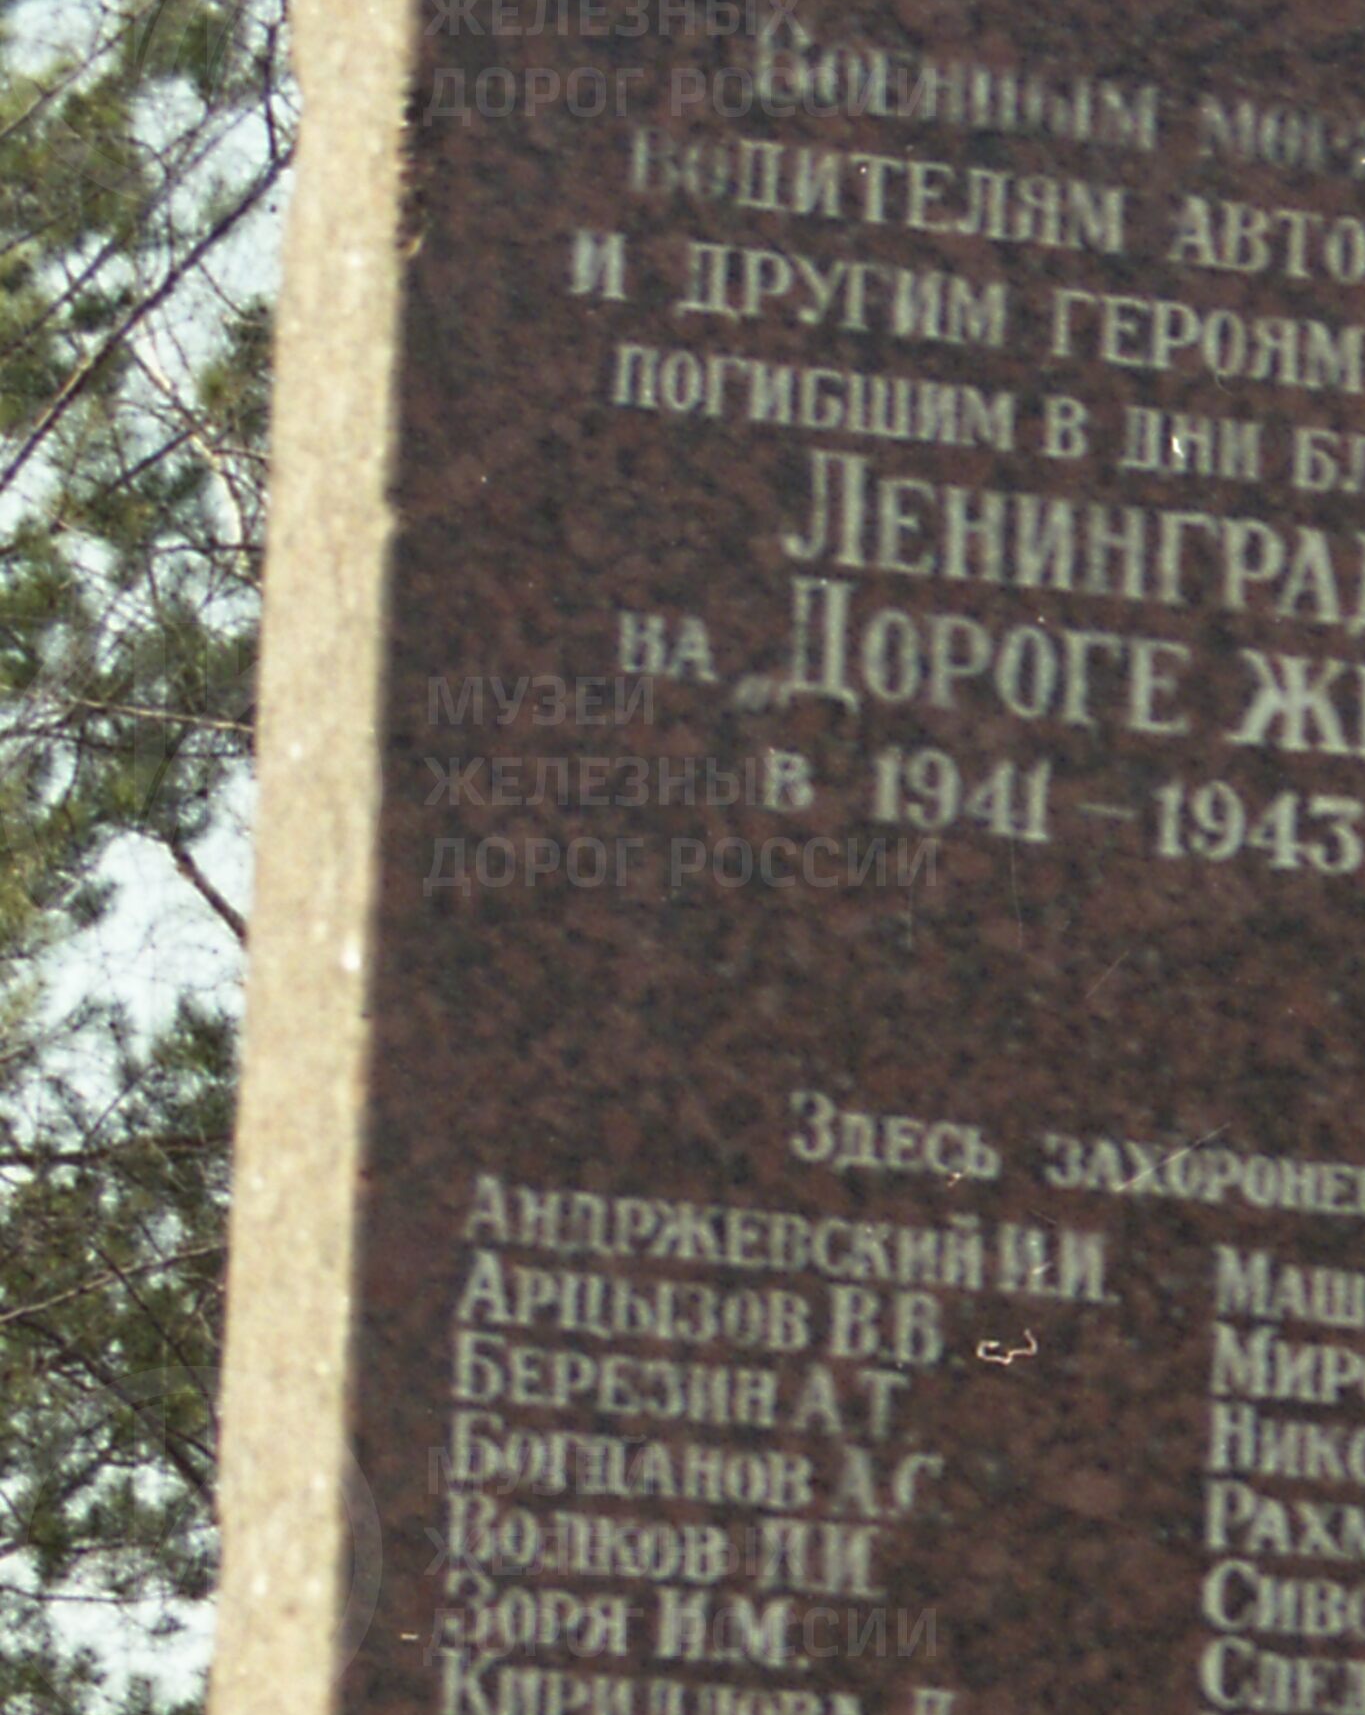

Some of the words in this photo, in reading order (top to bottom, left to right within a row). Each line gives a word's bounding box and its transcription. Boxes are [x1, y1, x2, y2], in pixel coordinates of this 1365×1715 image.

[676, 241, 1003, 350] ДРУГИМ
[1050, 289, 1365, 395] ГЕРОЯМ
[614, 342, 1016, 454] ПОГИБШИМ
[1118, 406, 1263, 483] ДНИ
[789, 1091, 999, 1181] ЗДЕСЬ
